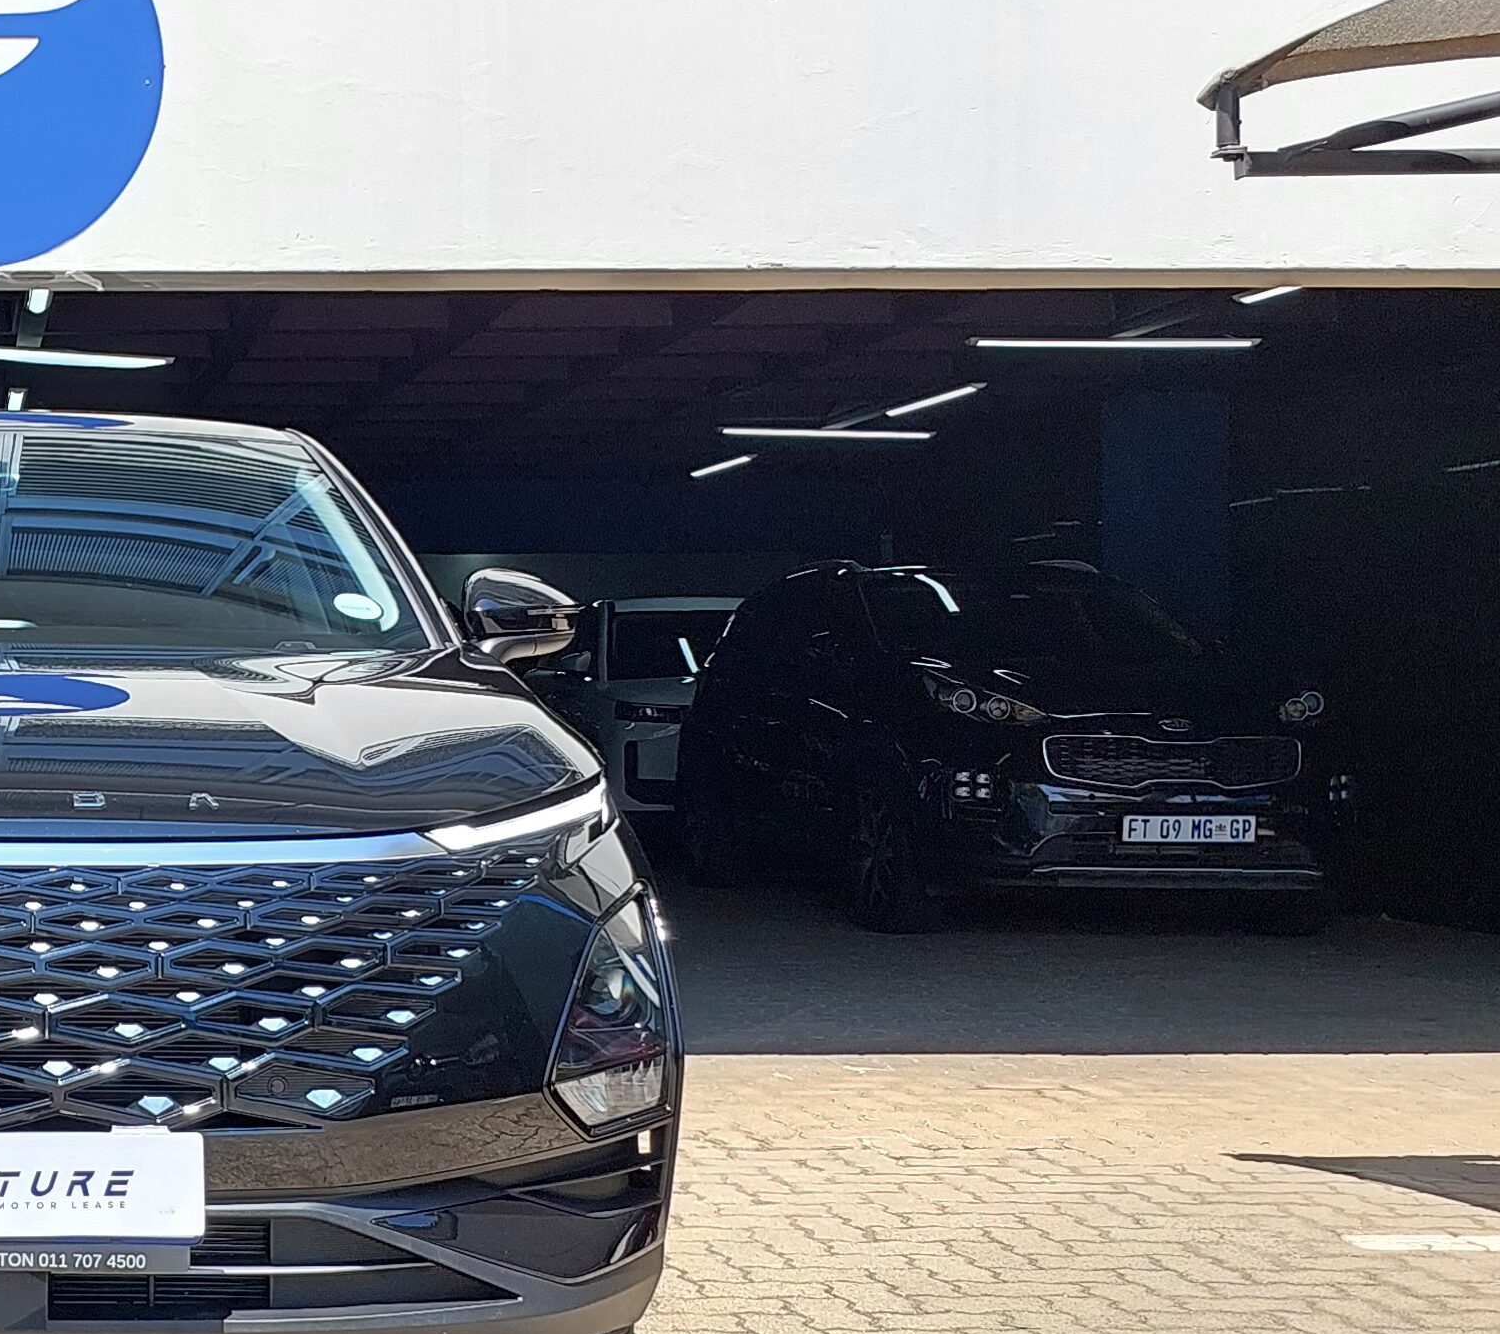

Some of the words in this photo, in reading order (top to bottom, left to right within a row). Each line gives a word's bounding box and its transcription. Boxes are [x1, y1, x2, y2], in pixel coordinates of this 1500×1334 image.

[1127, 819, 1150, 839] FT
[1160, 819, 1182, 839] 09
[1191, 819, 1213, 839] MG
[1229, 819, 1252, 839] GP
[71, 1201, 128, 1210] LEASE
[38, 1253, 68, 1268] 011
[73, 1253, 104, 1269] 707
[107, 1253, 146, 1269] 4500
